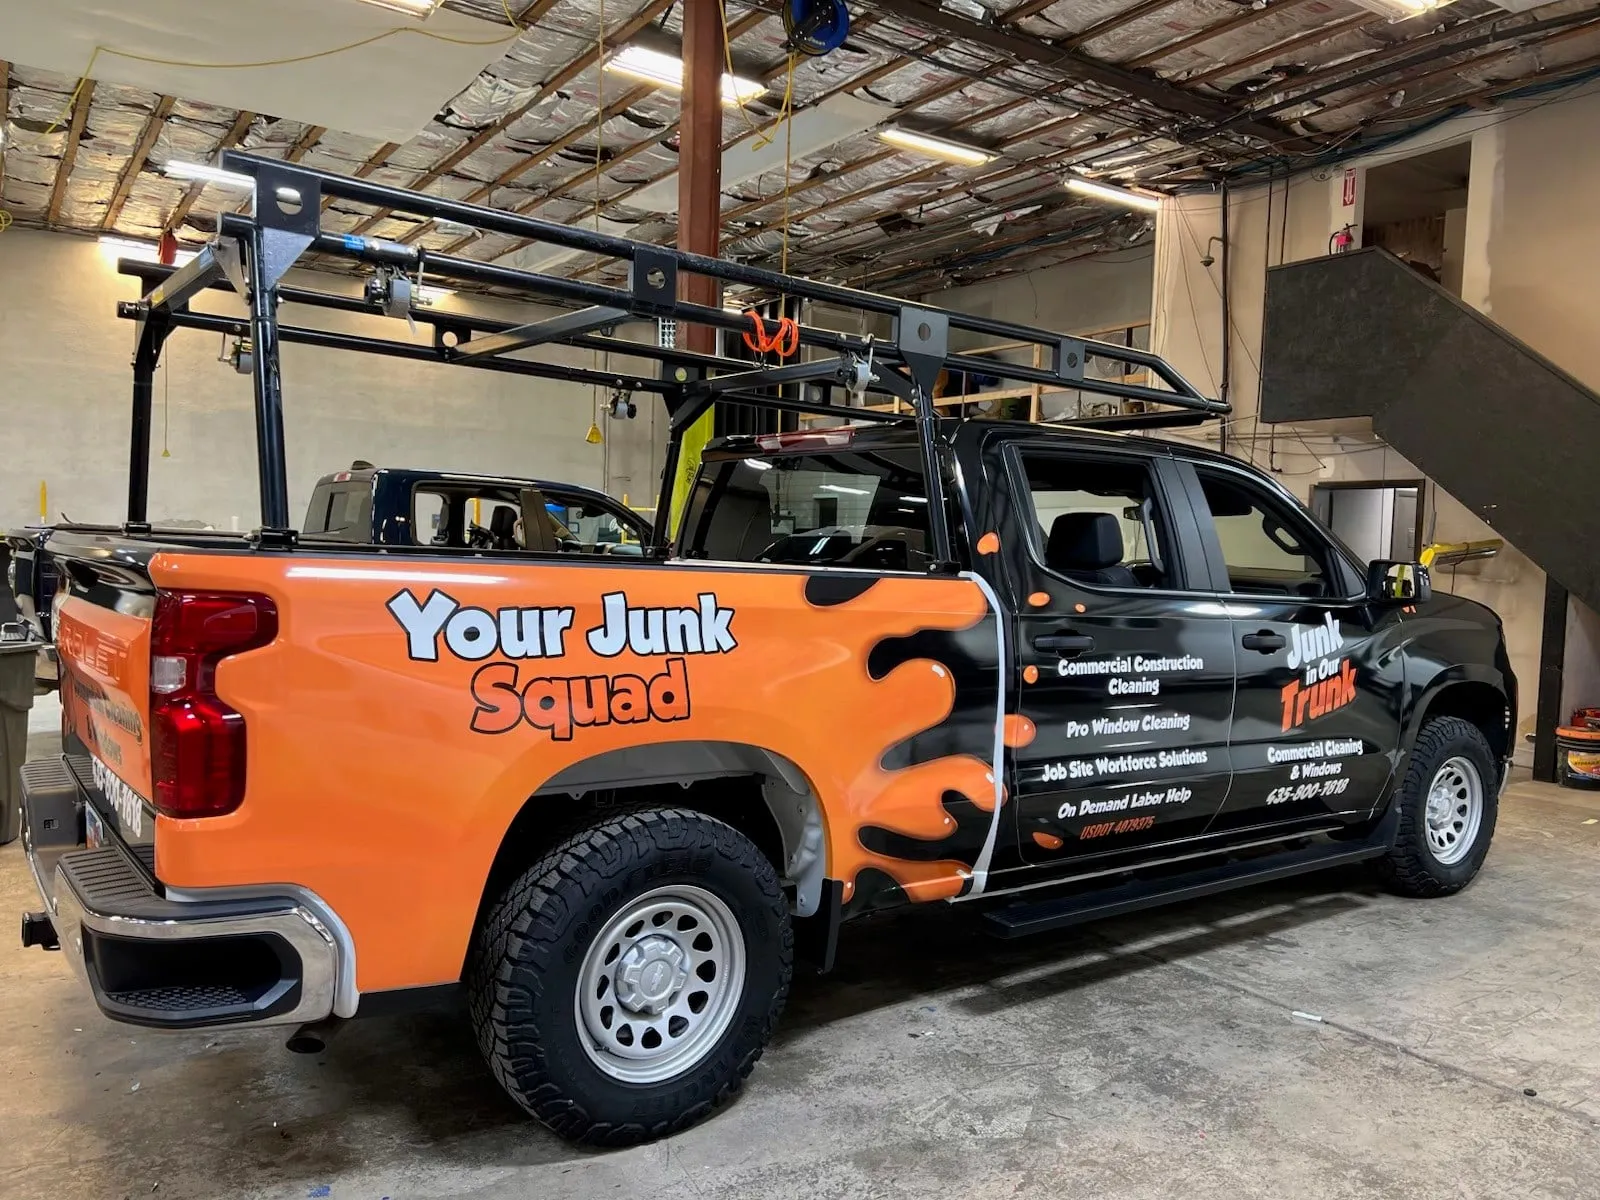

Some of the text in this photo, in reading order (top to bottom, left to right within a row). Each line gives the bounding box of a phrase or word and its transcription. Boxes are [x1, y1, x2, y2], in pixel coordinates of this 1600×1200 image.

[385, 588, 738, 662] Your Junk
[1287, 611, 1344, 669] Junk
[1058, 654, 1204, 676] Commercial Construction
[1305, 658, 1340, 686] in Our
[469, 657, 690, 741] Squad
[1108, 677, 1160, 695] Cleaning
[1281, 659, 1357, 732] Trunk
[1066, 713, 1191, 738] Pro Window Cleaning
[1267, 738, 1363, 763] Commercial Cleaning
[1041, 748, 1208, 782] Job Site Workforce Solutions
[1290, 761, 1342, 780] & Windows
[1057, 787, 1192, 819] On Demand Labor Help
[1265, 778, 1350, 805] 435-800-7818
[1080, 822, 1115, 840] USDOT
